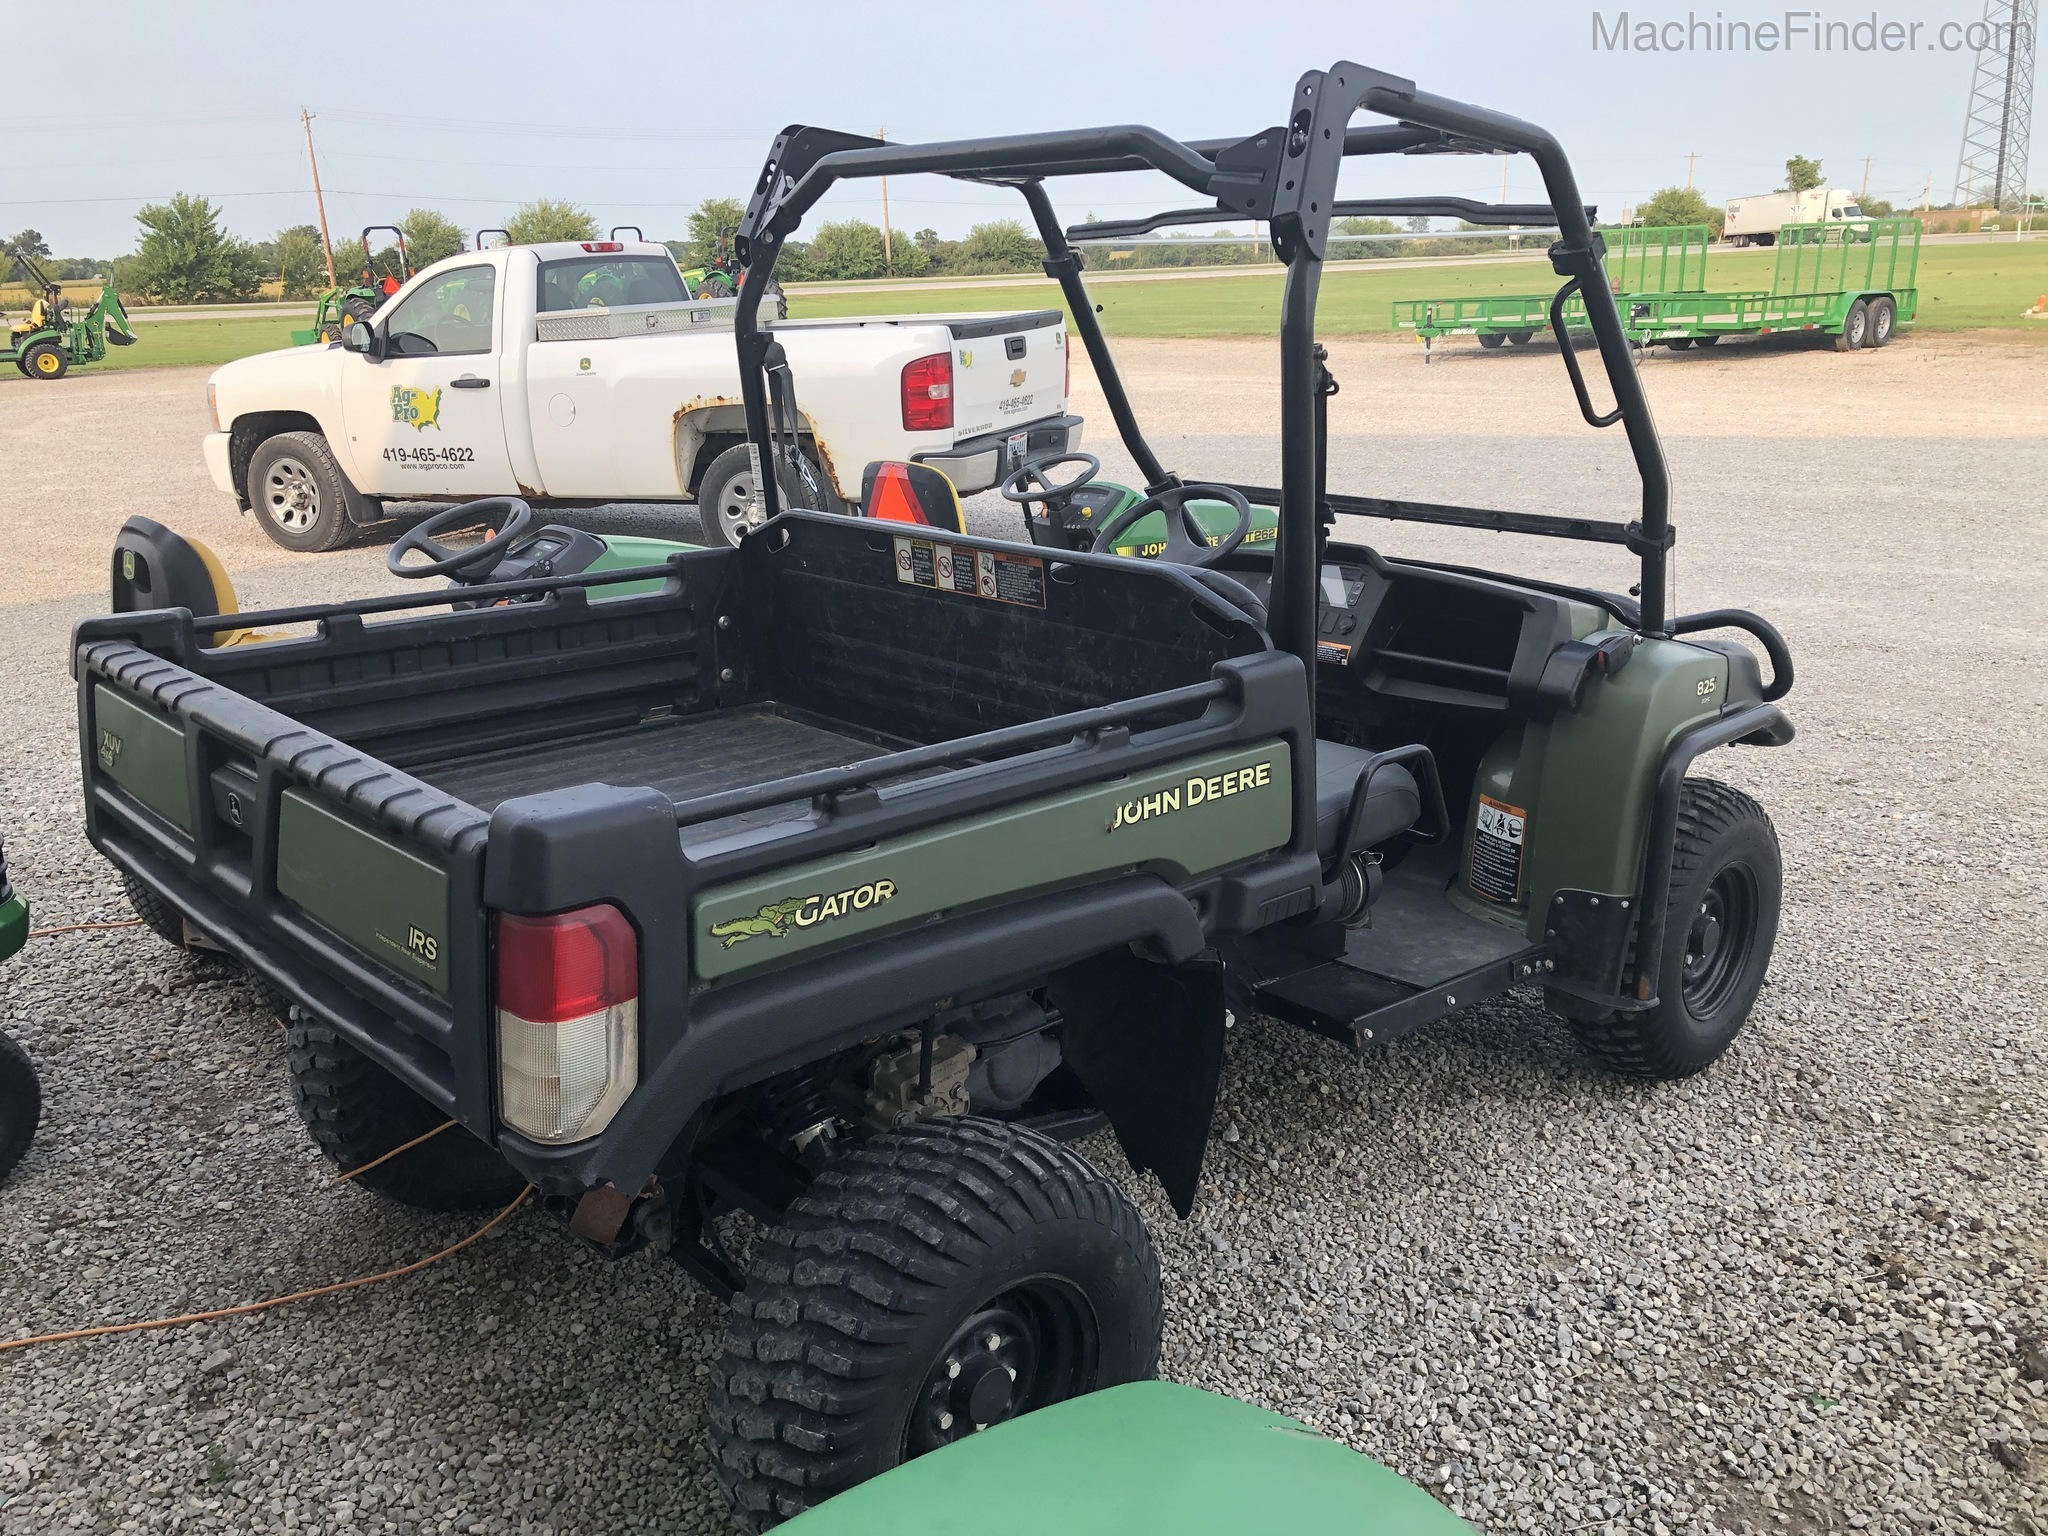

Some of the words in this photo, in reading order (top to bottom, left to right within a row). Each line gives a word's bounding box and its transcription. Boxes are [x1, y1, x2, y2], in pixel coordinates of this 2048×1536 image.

[999, 394, 1034, 411] 419-465-4622
[392, 403, 420, 422] Pro
[383, 447, 475, 462] 419-465-4622
[400, 463, 466, 472] www.agproco.com
[1141, 540, 1167, 557] JOH
[103, 730, 121, 754] XUV
[1112, 787, 1181, 831] JOHN
[1187, 762, 1271, 807] DEERE
[795, 879, 897, 927] GATOR
[409, 926, 438, 960] IRS
